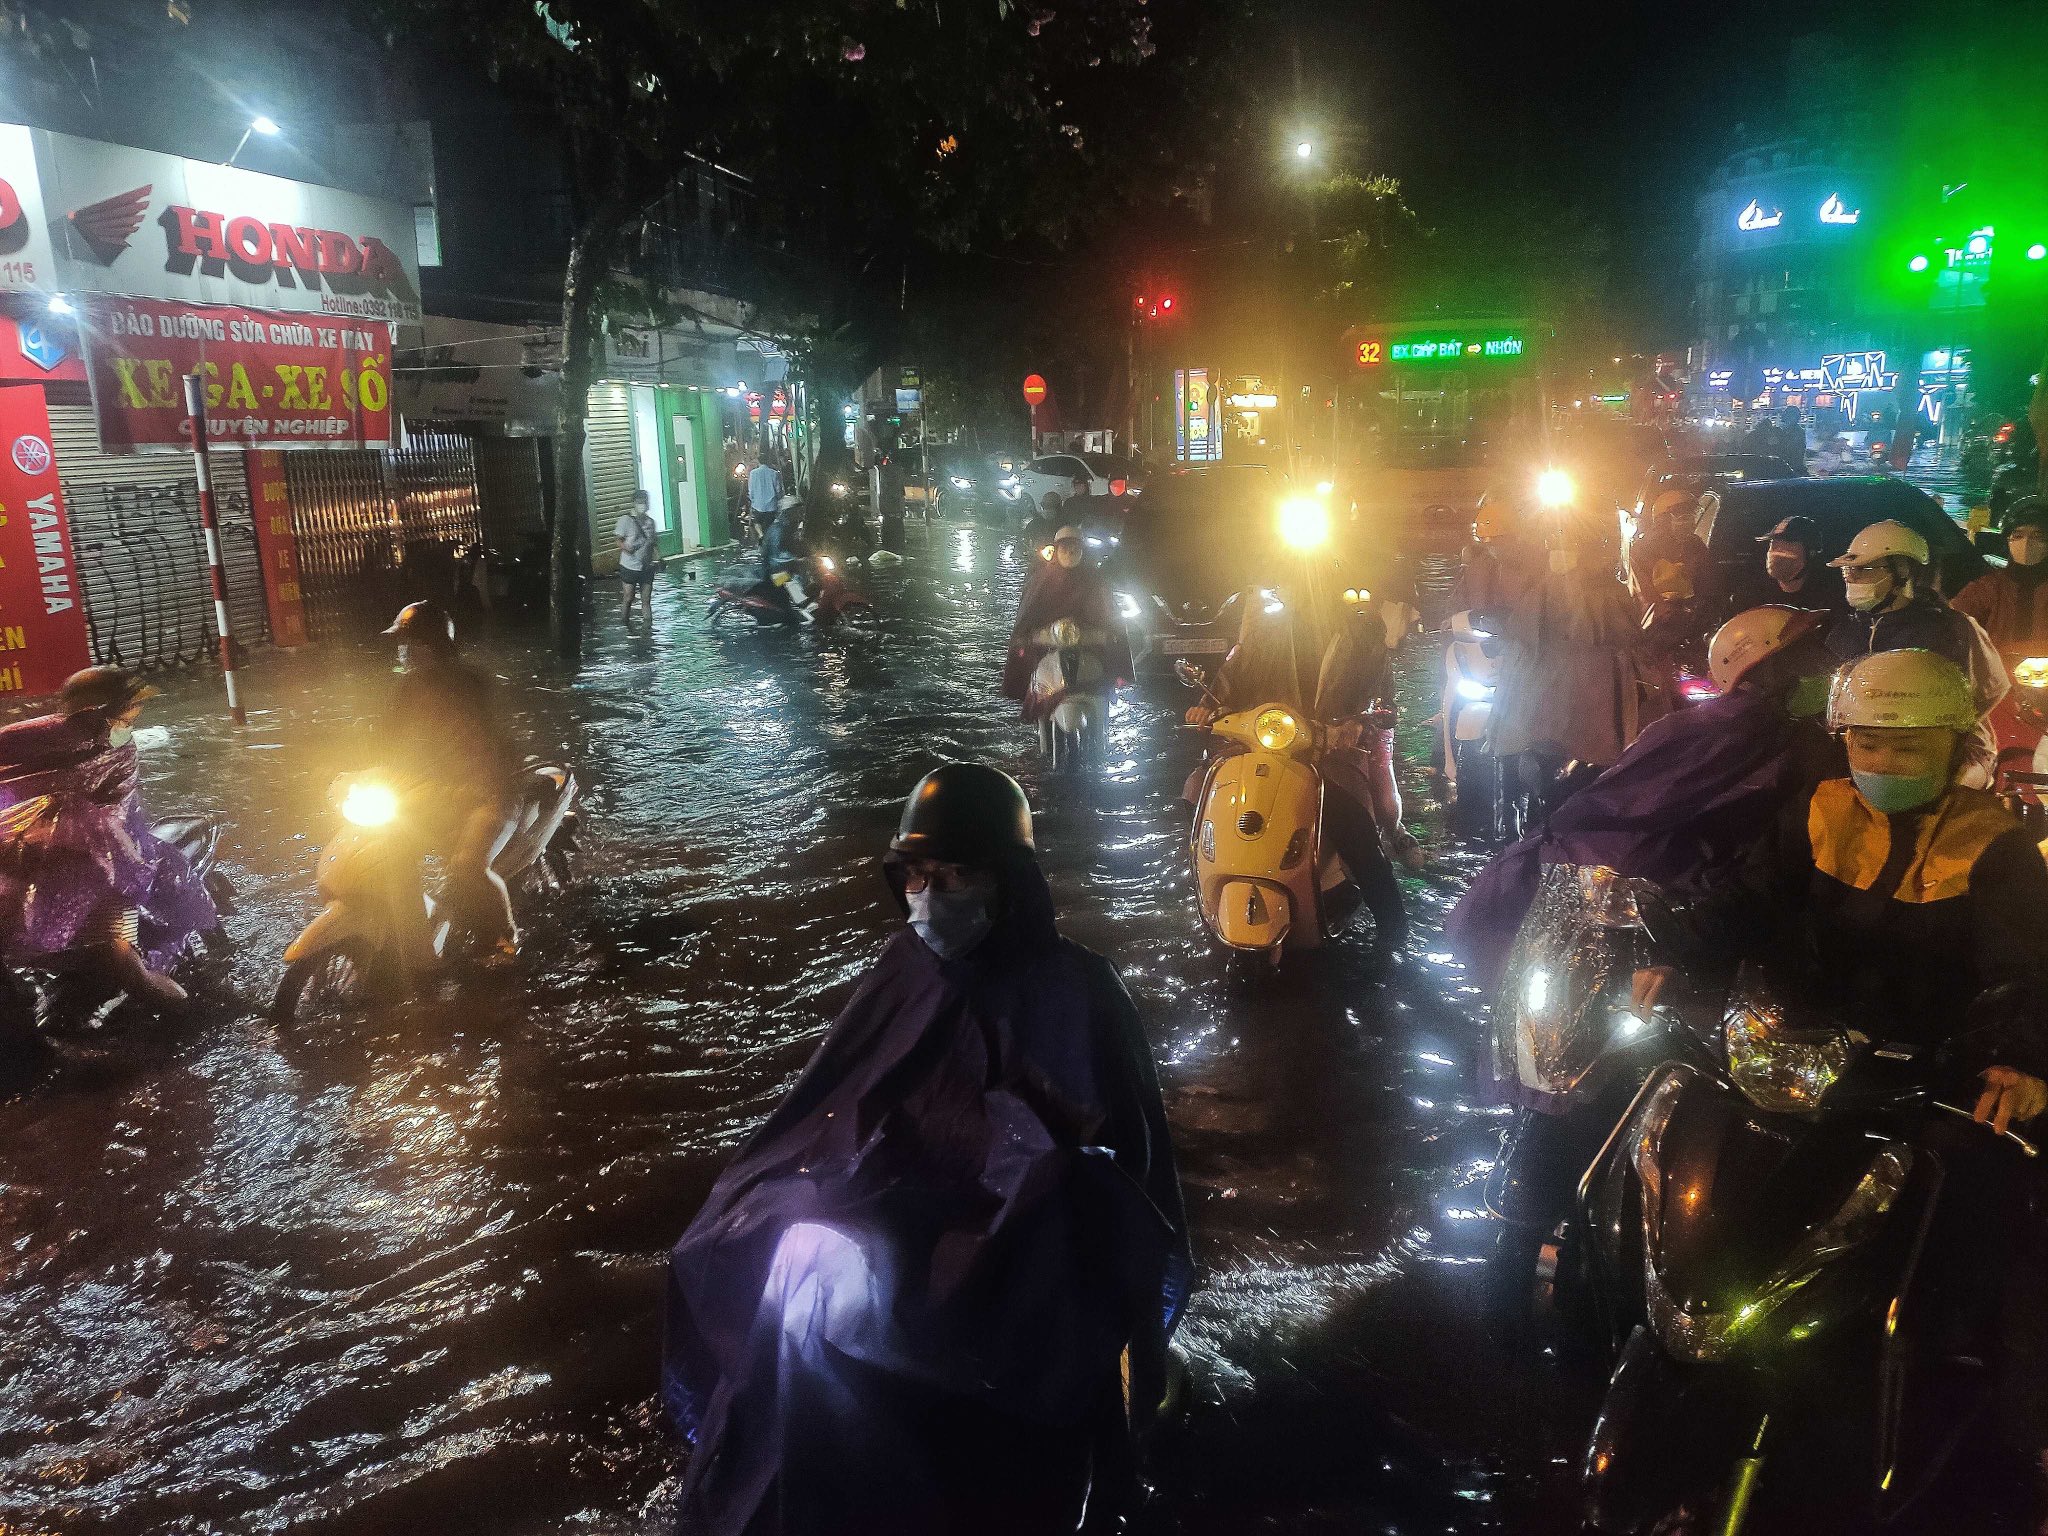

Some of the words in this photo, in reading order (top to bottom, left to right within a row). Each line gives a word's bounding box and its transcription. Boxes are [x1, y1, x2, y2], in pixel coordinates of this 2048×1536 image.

[165, 204, 410, 284] HONDA
[3, 262, 36, 283] 115
[230, 314, 266, 344] SỬA
[269, 321, 314, 347] CHỮA
[316, 327, 337, 348] XE
[1359, 342, 1380, 363] 32
[109, 357, 178, 409] XE
[340, 354, 388, 411] SỐ
[274, 415, 349, 438] NGHIỆP
[26, 493, 73, 615] YAMAHA
